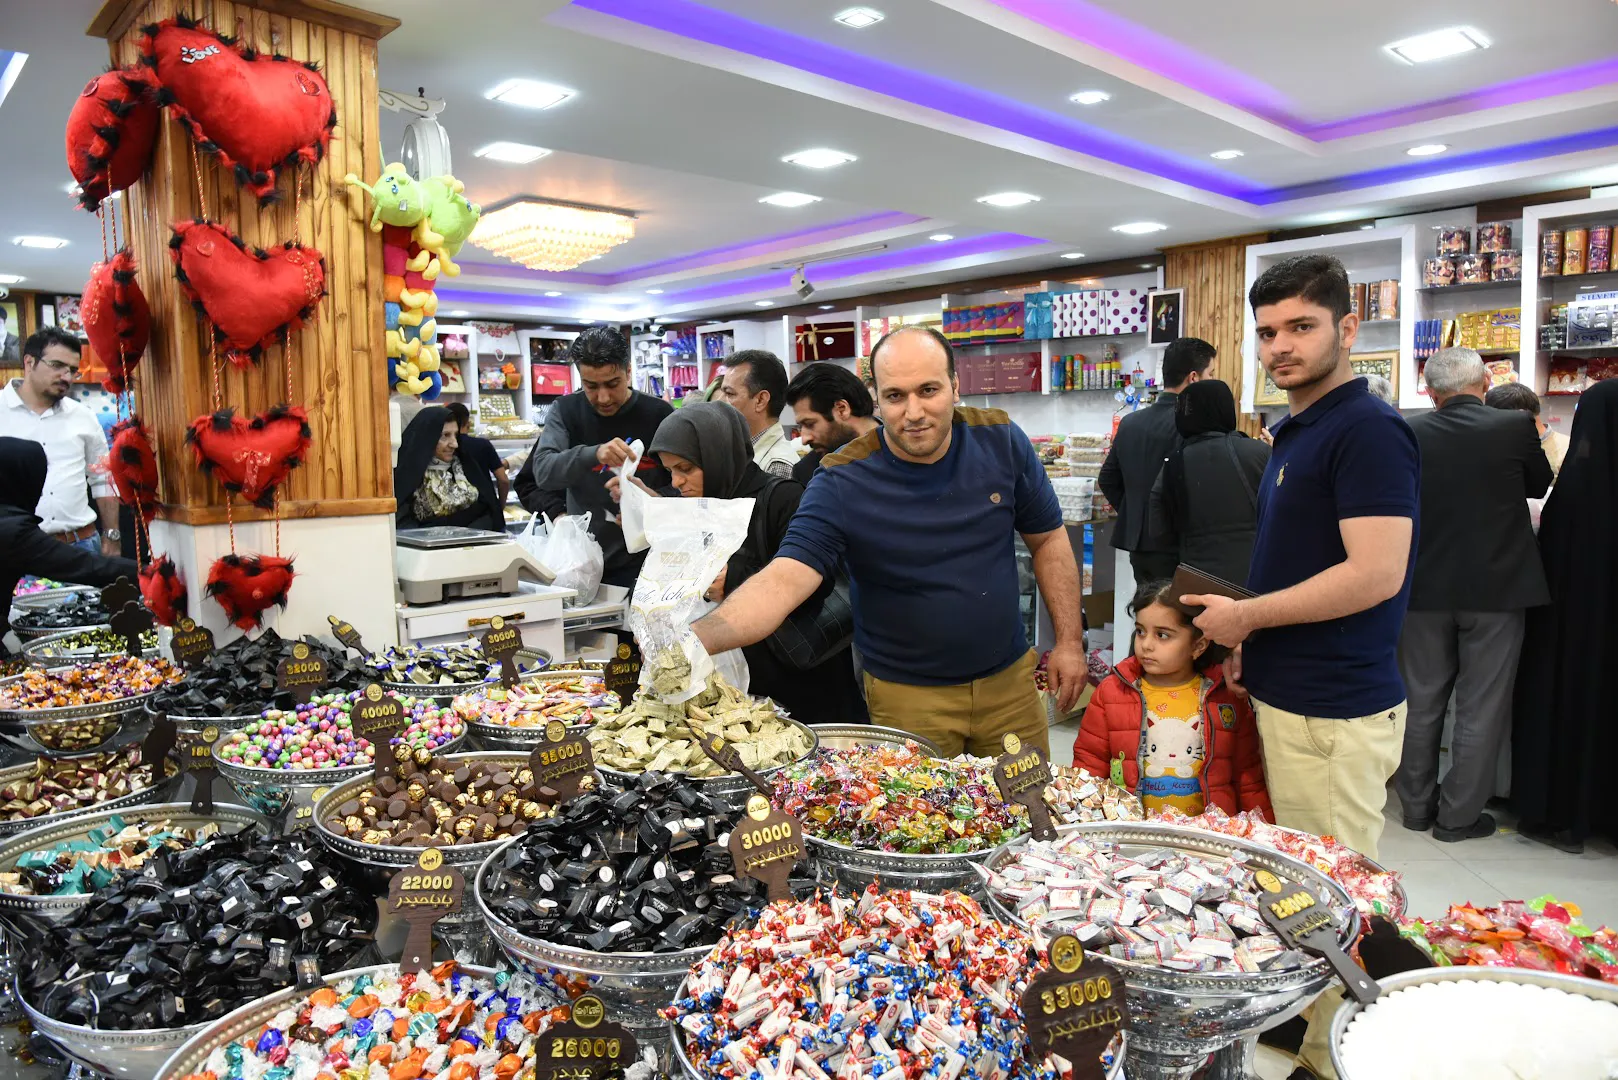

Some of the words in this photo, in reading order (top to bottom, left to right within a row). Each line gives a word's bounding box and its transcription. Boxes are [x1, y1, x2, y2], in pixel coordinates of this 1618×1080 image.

[487, 629, 516, 644] 30000
[286, 661, 321, 675] 32000
[361, 703, 397, 719] 40000
[540, 741, 583, 766] 35000
[1003, 752, 1040, 779] 37000
[741, 822, 792, 850] 30000
[401, 875, 453, 890] 22000
[1041, 976, 1112, 1015] 33000
[551, 1038, 620, 1059] 26000
